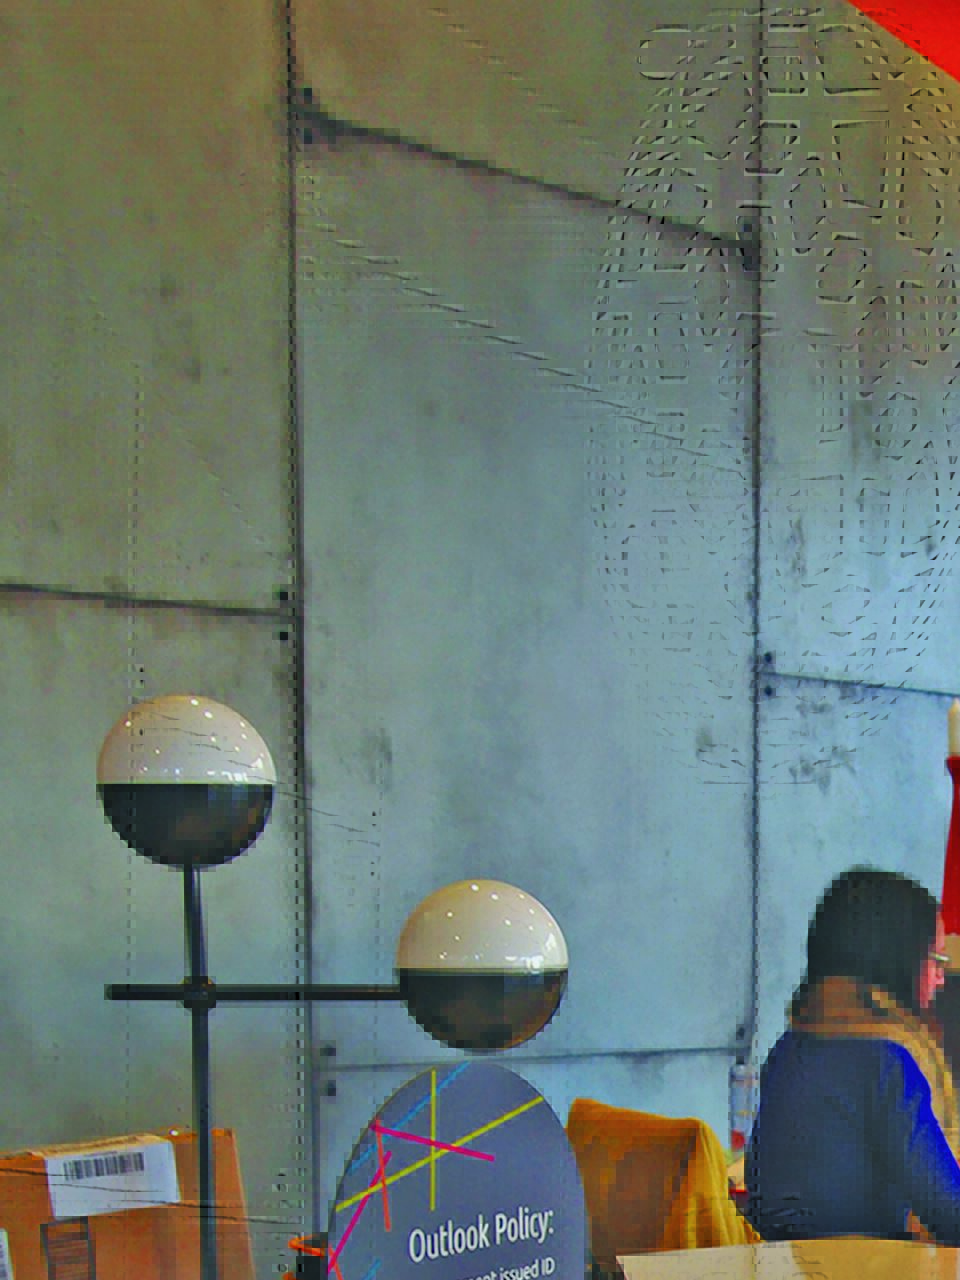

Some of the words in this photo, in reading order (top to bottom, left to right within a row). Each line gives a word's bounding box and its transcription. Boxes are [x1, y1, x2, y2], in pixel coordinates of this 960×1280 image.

[409, 1214, 490, 1263] Outlook
[495, 1206, 554, 1244] Policy:
[541, 1257, 555, 1275] ID
